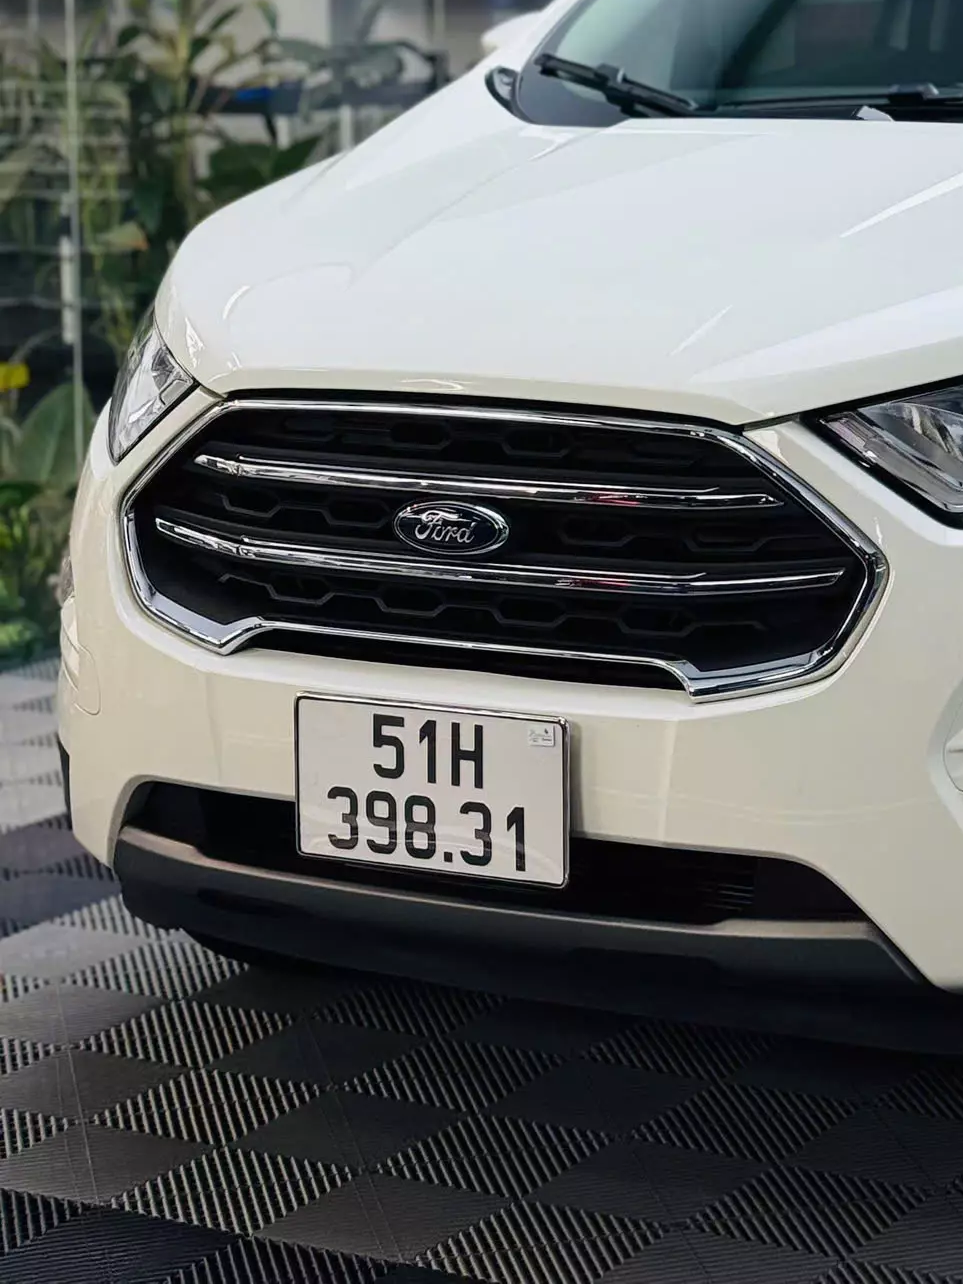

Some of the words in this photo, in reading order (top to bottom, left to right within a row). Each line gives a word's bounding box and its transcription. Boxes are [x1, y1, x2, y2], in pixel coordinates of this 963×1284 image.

[402, 508, 476, 544] Ford
[373, 713, 483, 789] 51H
[327, 786, 526, 872] 398.31
